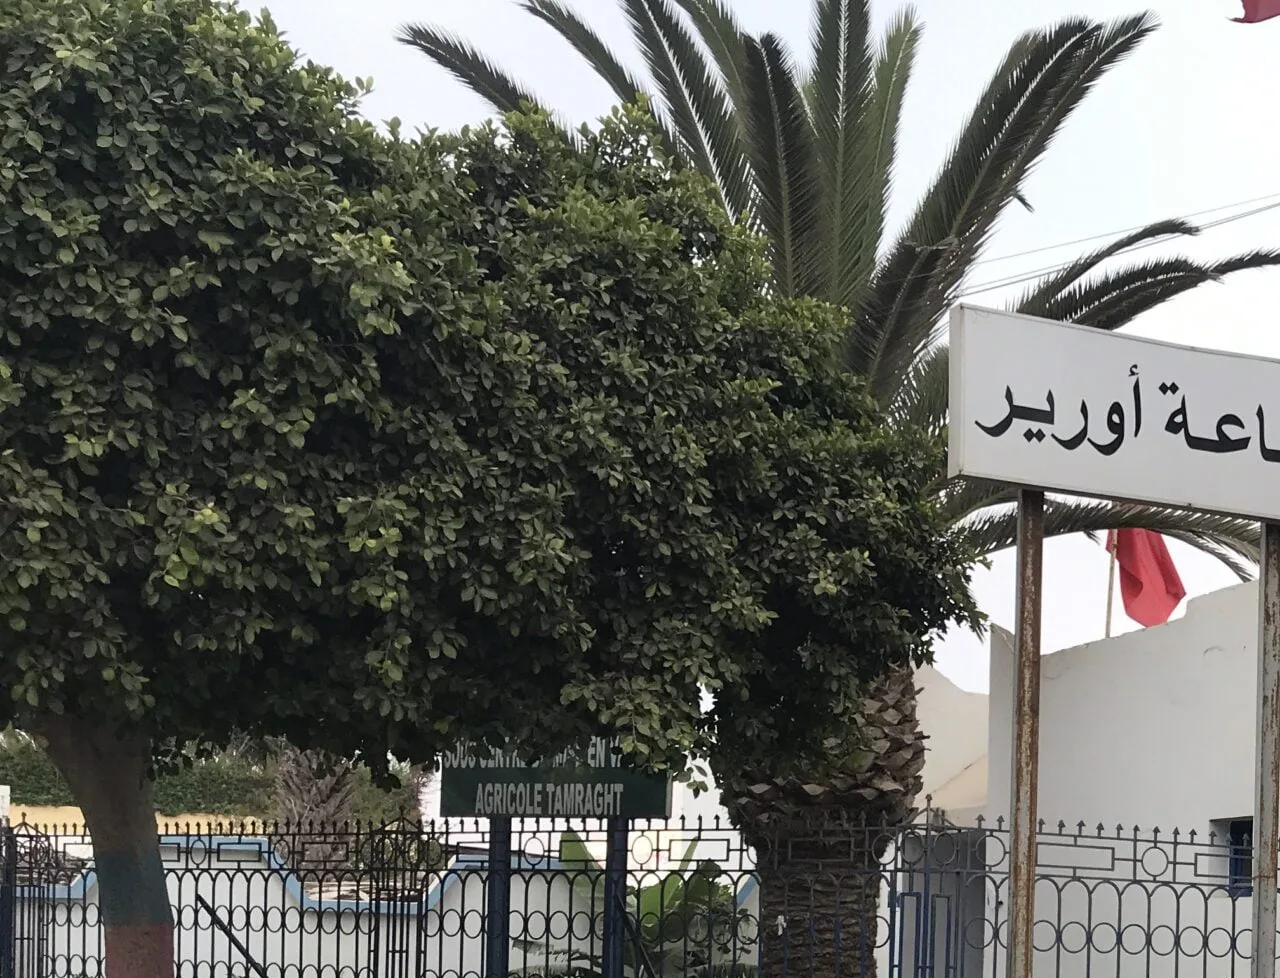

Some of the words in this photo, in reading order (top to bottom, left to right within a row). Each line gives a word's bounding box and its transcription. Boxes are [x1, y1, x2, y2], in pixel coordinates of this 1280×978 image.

[974, 364, 1142, 456] أورير
[475, 783, 542, 815] AGRICOLE
[546, 783, 624, 815] TAMRAGHT
